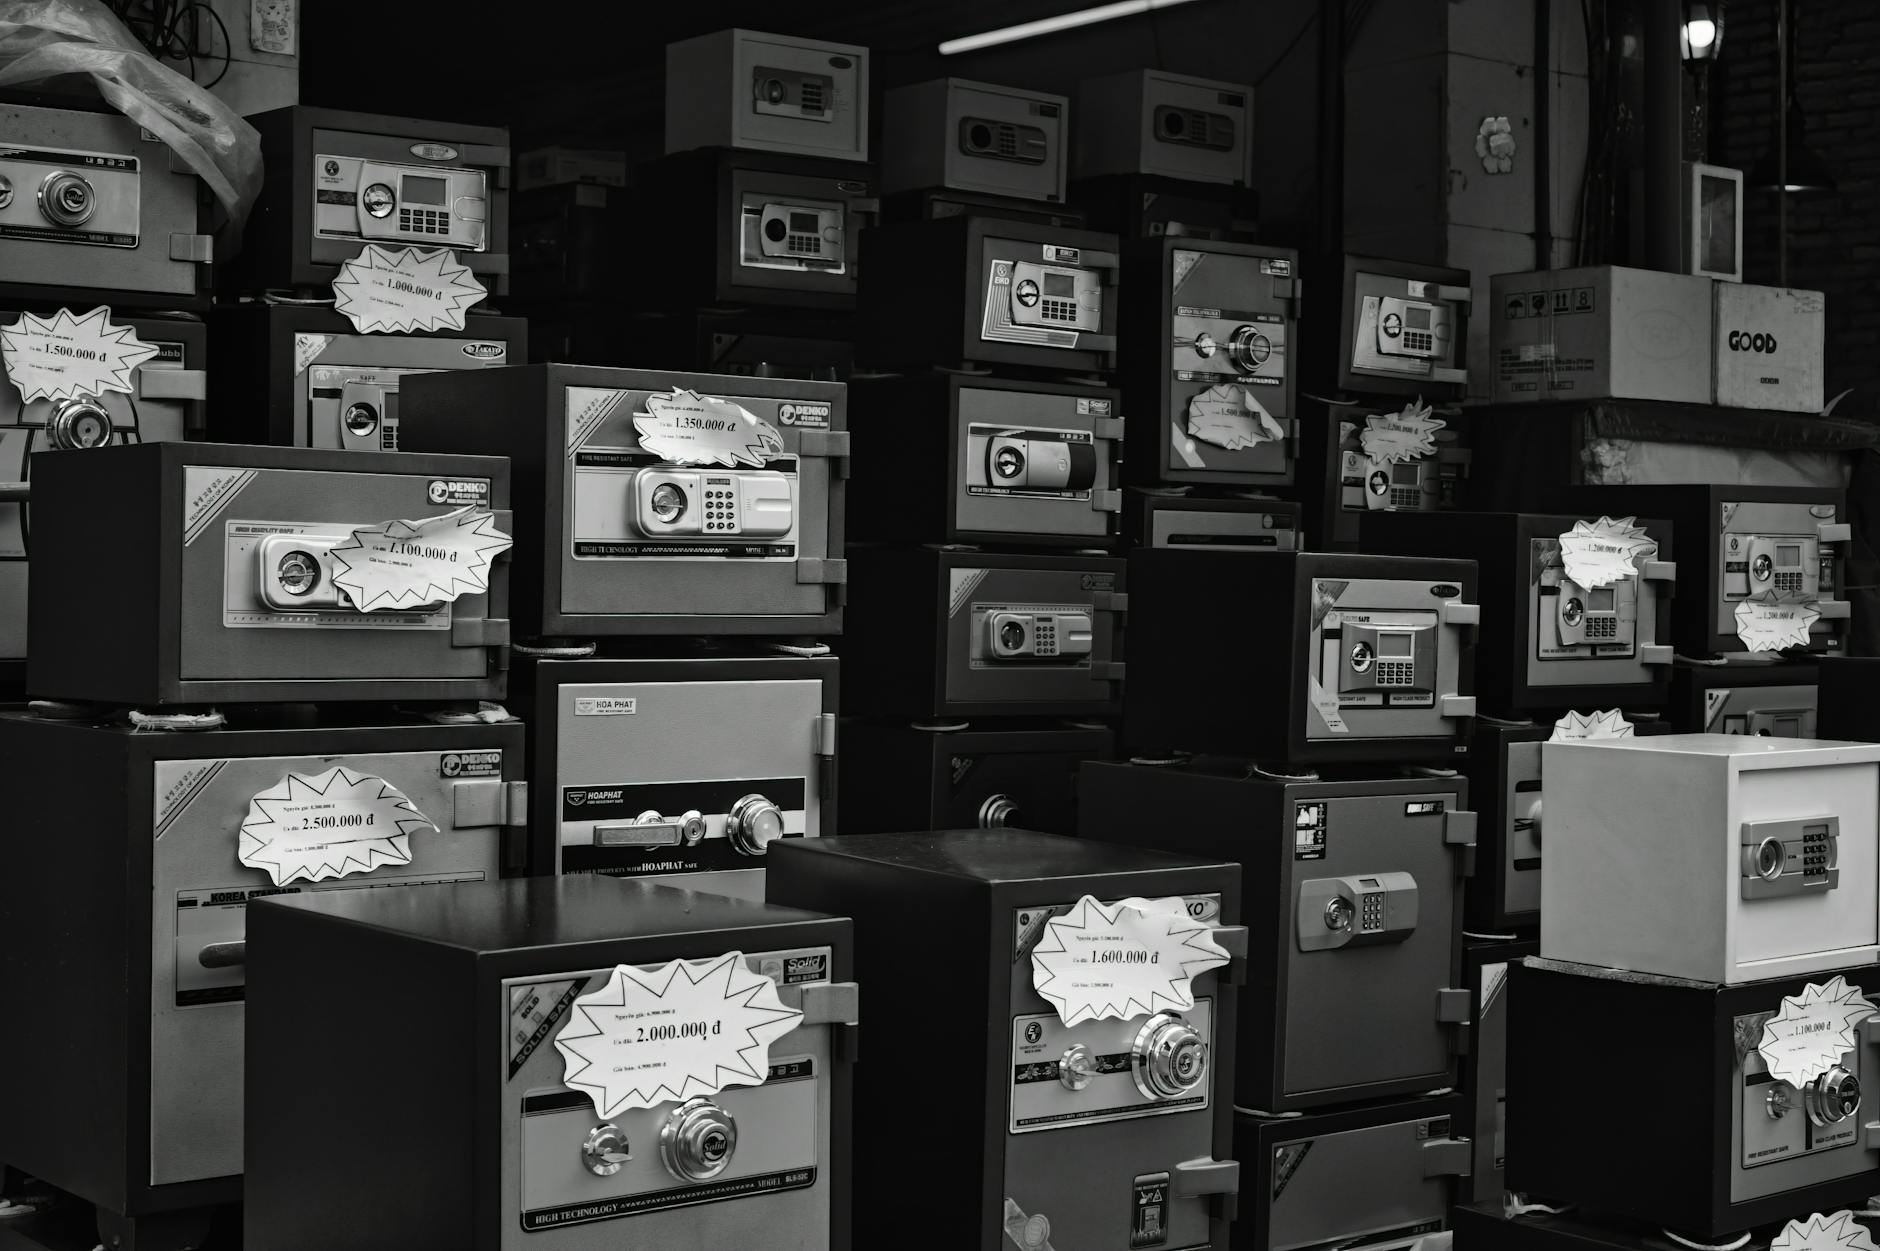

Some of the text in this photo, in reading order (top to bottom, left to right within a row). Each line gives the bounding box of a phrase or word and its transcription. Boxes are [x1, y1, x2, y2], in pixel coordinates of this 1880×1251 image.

[387, 278, 432, 298] 1.000.000
[1729, 330, 1777, 354] GOOD
[44, 342, 96, 362] 1.500.000
[795, 405, 829, 417] DENKO
[675, 416, 725, 432] 1.350.000
[448, 481, 488, 494] DENKO
[390, 542, 446, 561] 1.100.000
[596, 700, 633, 709] HOA PHAT
[461, 752, 500, 764] DENKO
[587, 790, 624, 801] HOAPHAT
[302, 814, 362, 830] 2.500.000
[642, 861, 684, 872] HOAPHAT
[210, 891, 247, 903] KOREA
[1091, 950, 1148, 965] 1.600.000
[636, 1021, 708, 1043] 2.000.000
[535, 1212, 559, 1225] HIGH
[560, 1203, 620, 1222] TECHNOLOGY
